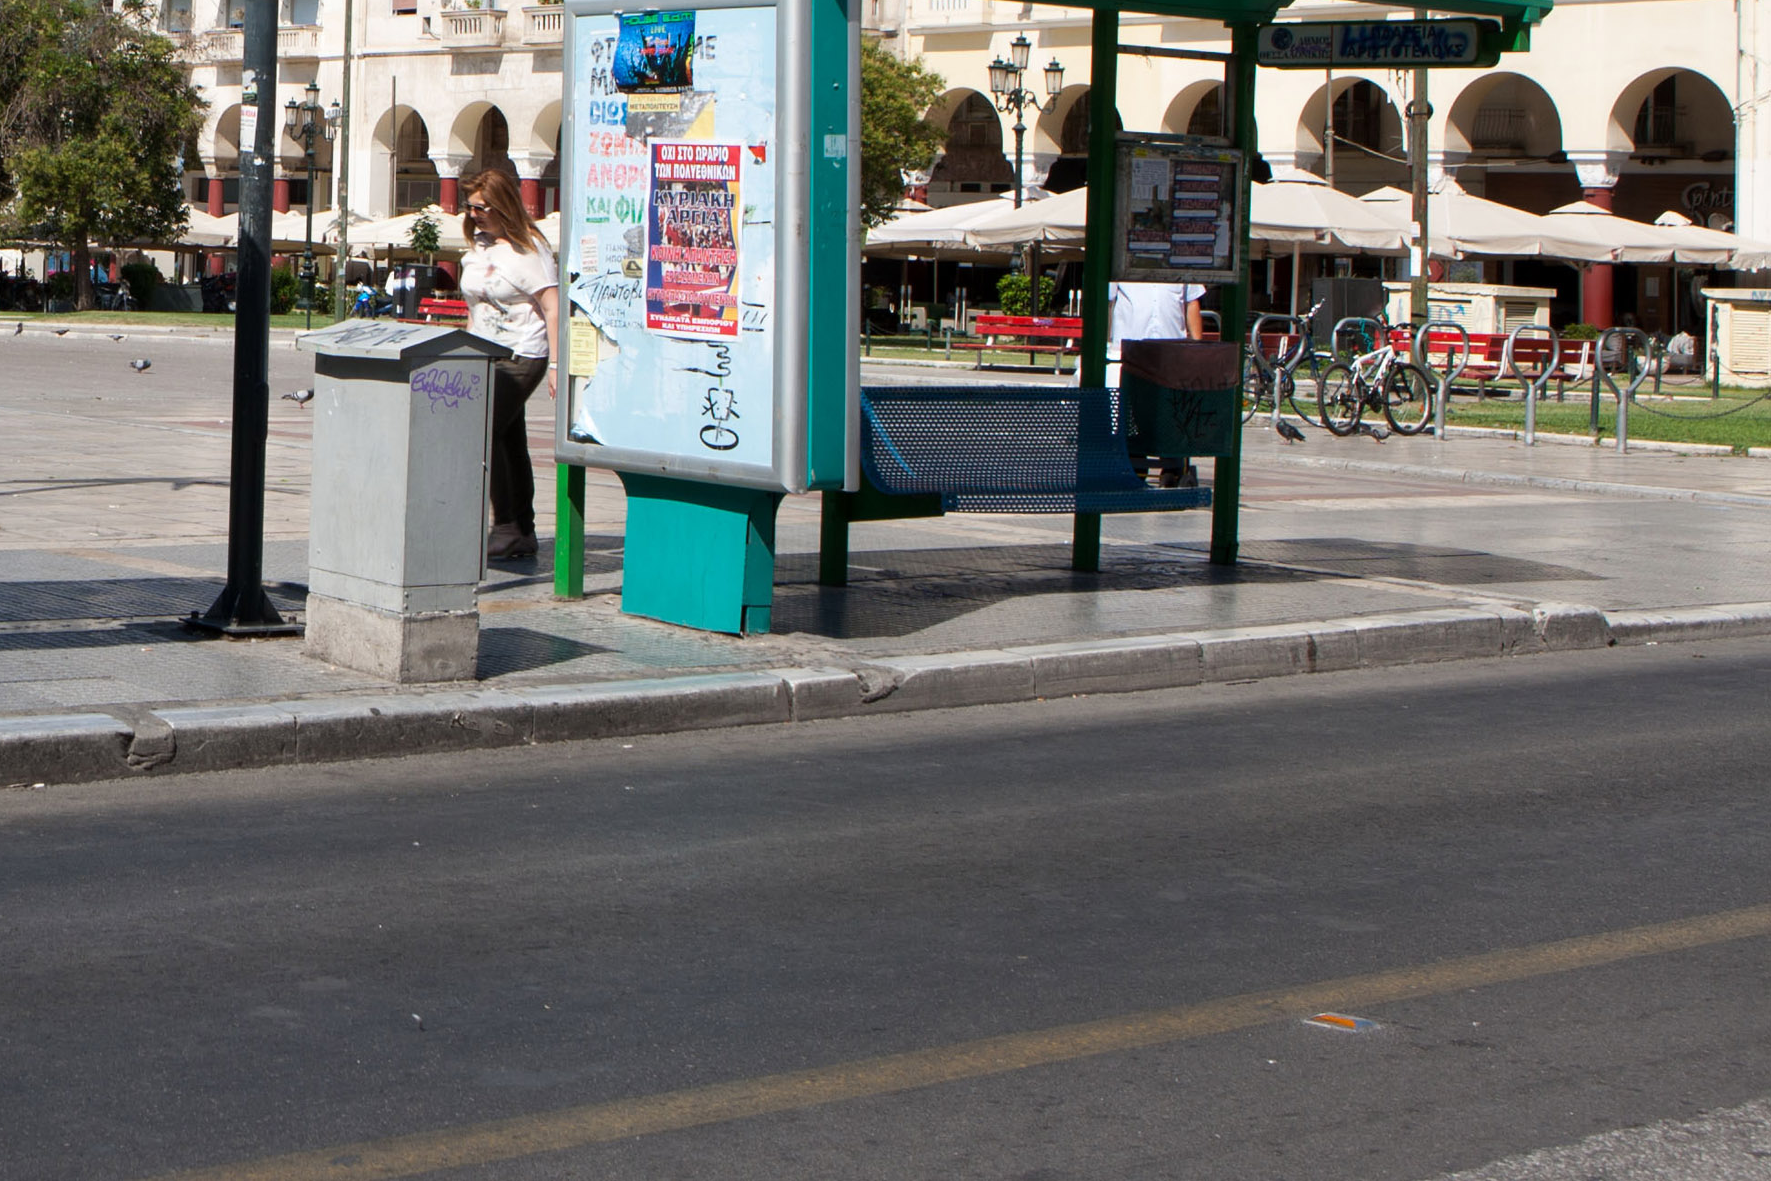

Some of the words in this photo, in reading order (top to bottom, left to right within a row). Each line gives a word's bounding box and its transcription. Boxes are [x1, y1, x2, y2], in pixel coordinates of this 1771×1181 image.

[661, 145, 676, 160] ΟΧΙ
[677, 145, 693, 161] ΣΤΟ
[695, 146, 729, 162] ΩΡΑΡΙΟ
[654, 163, 671, 178] ΤΩΝ
[673, 163, 736, 180] ΠΟΛΥΕΘΝΙΚΩΝ
[653, 189, 736, 210] ΚΥΡΙΑΚΗ
[1681, 181, 1734, 217] Spint
[666, 208, 720, 226] ΑΡΓΙΑ
[651, 245, 682, 262] ΚΟΙΝΗ
[683, 247, 737, 267] ΑΠΑΝΤΗΣΗ
[664, 271, 720, 286] ΕΡΓΑΖΟΜΕΝΩΝ
[650, 314, 691, 324] ΣΥΝΔΙΚΑΤΑ
[692, 317, 734, 327] ΕΜΠΟΡΙΟΥ
